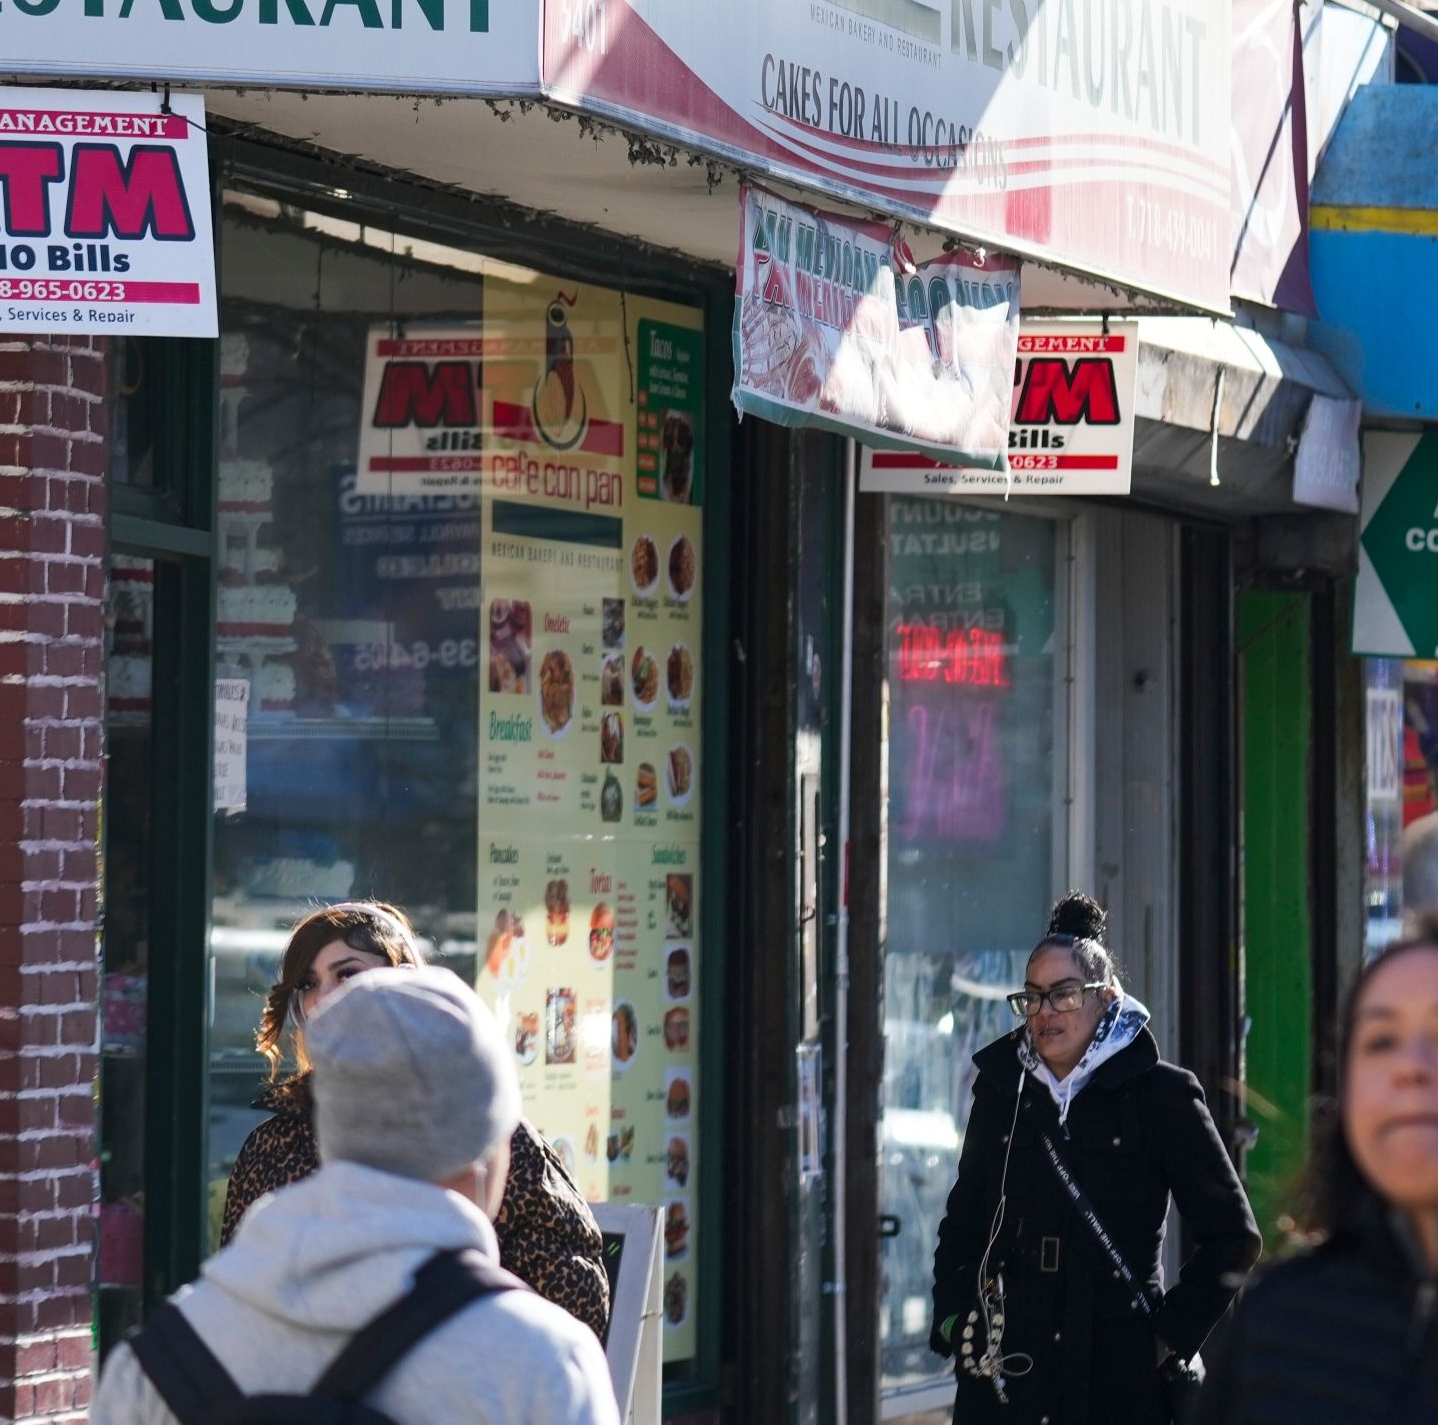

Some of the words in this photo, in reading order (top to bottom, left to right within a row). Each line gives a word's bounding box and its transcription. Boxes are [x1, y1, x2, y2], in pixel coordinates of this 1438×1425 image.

[762, 53, 822, 128] CAKES
[829, 77, 865, 139] FOR
[872, 94, 899, 152] ALL
[908, 107, 1007, 189] OCCASIONS
[48, 243, 130, 273] Bills
[8, 307, 67, 322] Services
[89, 309, 136, 324] Repair
